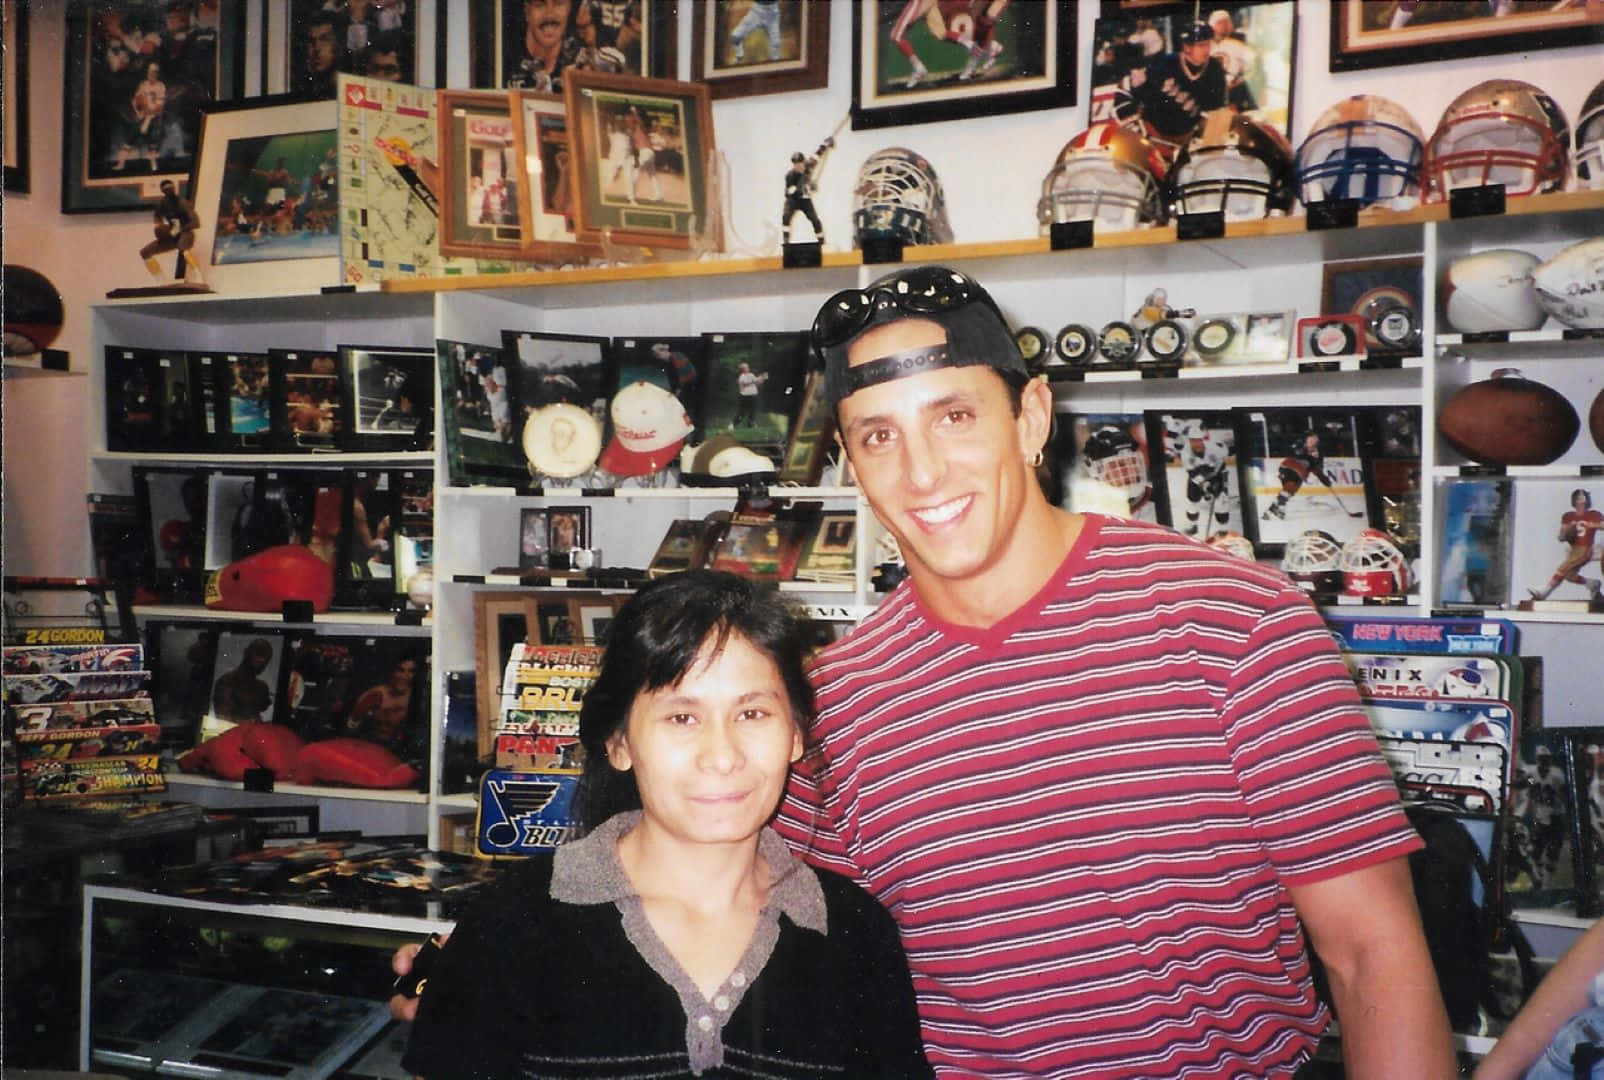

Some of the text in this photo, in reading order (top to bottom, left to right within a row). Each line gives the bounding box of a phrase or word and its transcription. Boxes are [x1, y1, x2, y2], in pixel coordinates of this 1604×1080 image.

[25, 629, 104, 644] 24 GORDON
[1352, 624, 1444, 642] NEW YORK
[20, 707, 52, 731] 3
[50, 731, 100, 741] GORDON
[96, 773, 163, 789] CHAMPION
[521, 826, 575, 846] BLU
